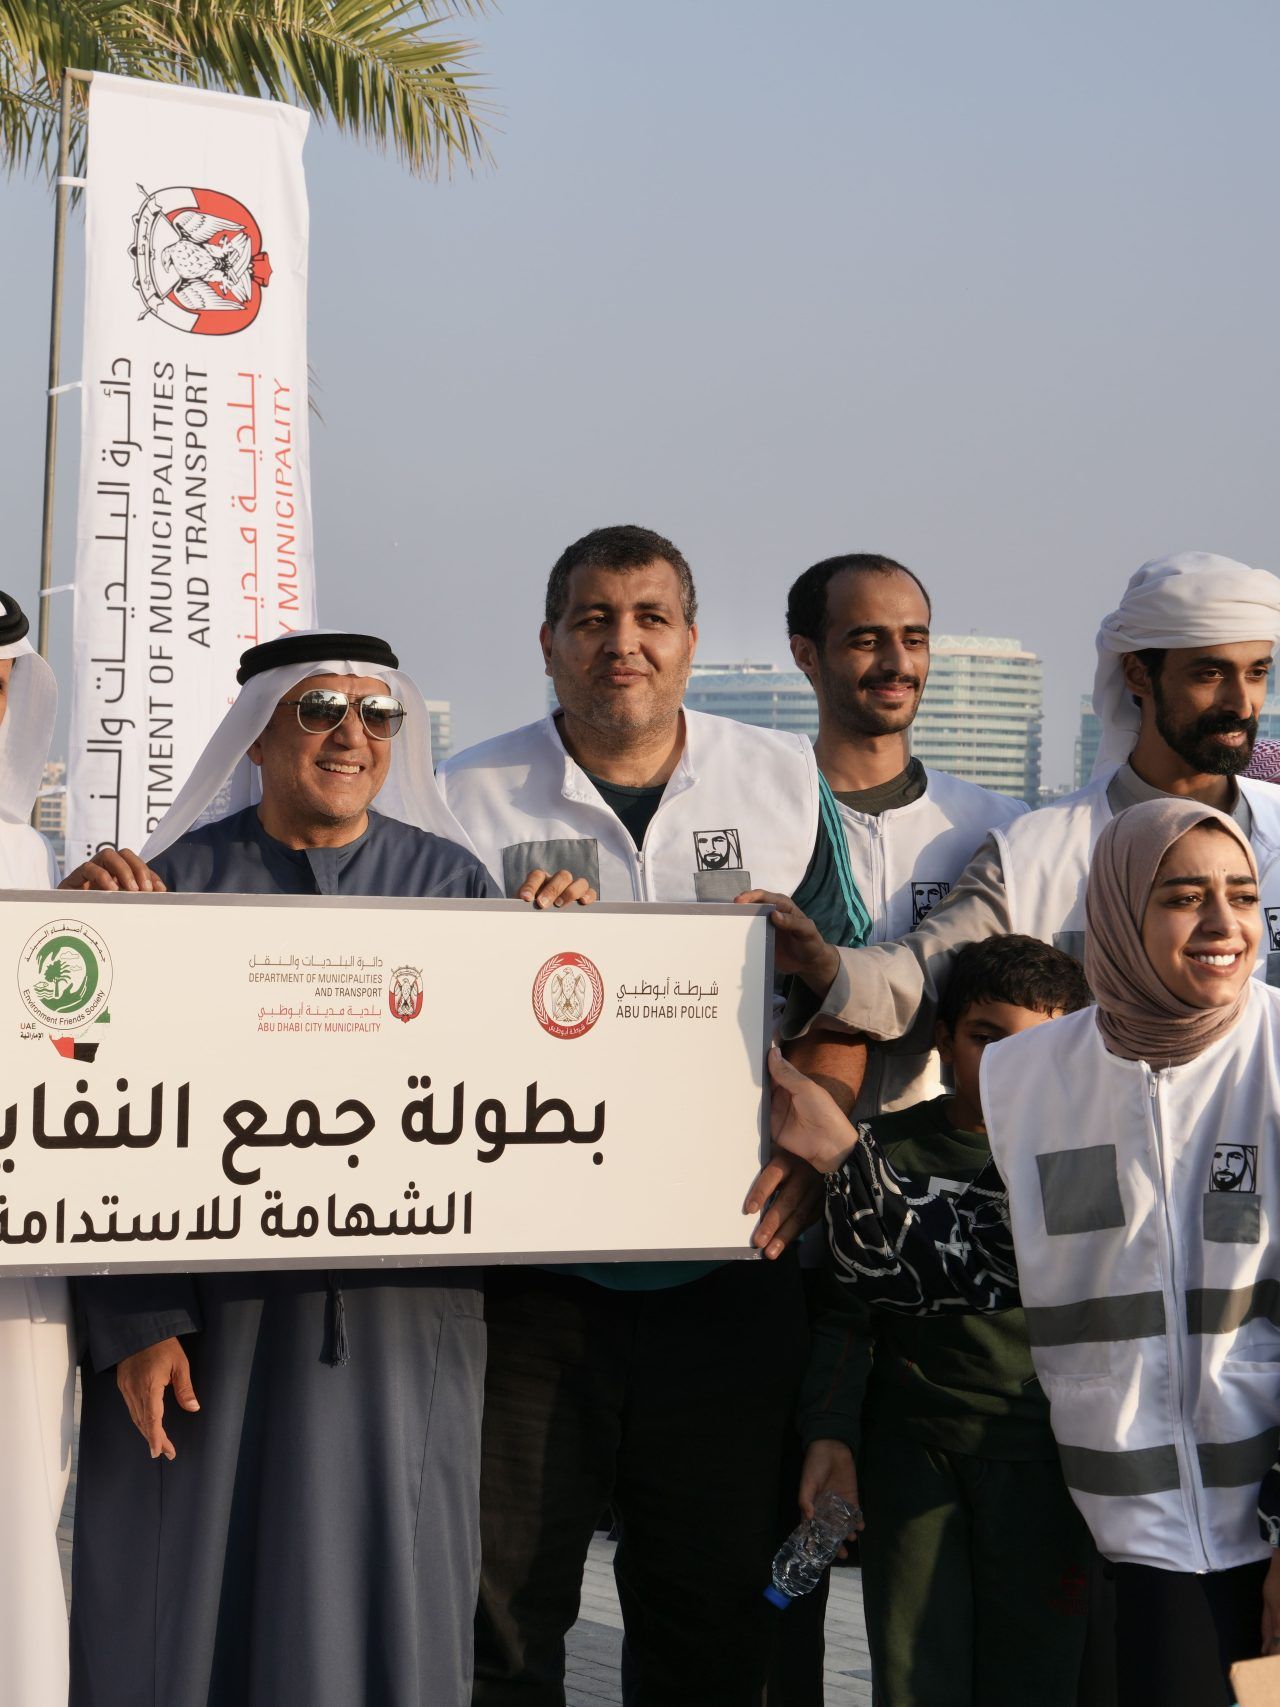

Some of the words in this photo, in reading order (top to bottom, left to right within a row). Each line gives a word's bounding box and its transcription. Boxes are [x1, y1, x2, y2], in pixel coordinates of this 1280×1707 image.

[100, 358, 142, 467] دائرة
[227, 373, 262, 513] بلدية
[185, 364, 207, 564] TRANSPORT
[150, 362, 174, 633] MUNICIPALITIES
[274, 378, 301, 610] MUNICIPALITY
[91, 482, 136, 703] البلديات
[236, 527, 265, 645] مدين
[187, 577, 210, 648] AND
[149, 645, 173, 683] OF
[147, 696, 173, 833] RTMENT
[86, 718, 136, 855] والنق
[249, 955, 299, 970] والنقل
[249, 973, 304, 982] DEPARTMENT
[307, 974, 316, 982] OF
[319, 974, 382, 983] MUNICIPALITIES
[302, 955, 354, 969] البلديات
[357, 956, 383, 970] دائرة
[23, 988, 58, 1026] Environment
[59, 1012, 86, 1027] Friends
[85, 989, 106, 1016] Society
[315, 988, 332, 996] AND
[335, 988, 382, 997] TRANSPORT
[617, 977, 670, 1002] أبوظبي
[674, 980, 718, 1001] شرطة
[258, 1003, 303, 1020] أبوظبي
[258, 1023, 274, 1031] ABU
[278, 1023, 302, 1031] DHABI
[305, 1023, 322, 1032] CITY
[325, 1023, 380, 1032] MUNICIPALITY
[306, 1005, 344, 1018] مدينة
[347, 1005, 381, 1018] بلدية
[616, 1006, 639, 1018] ABU
[643, 1006, 676, 1018] DHABI
[681, 1006, 717, 1018] POLICE
[402, 1076, 605, 1165] بطولة
[222, 1099, 375, 1185] جمع
[260, 1181, 472, 1239] الشهامة
